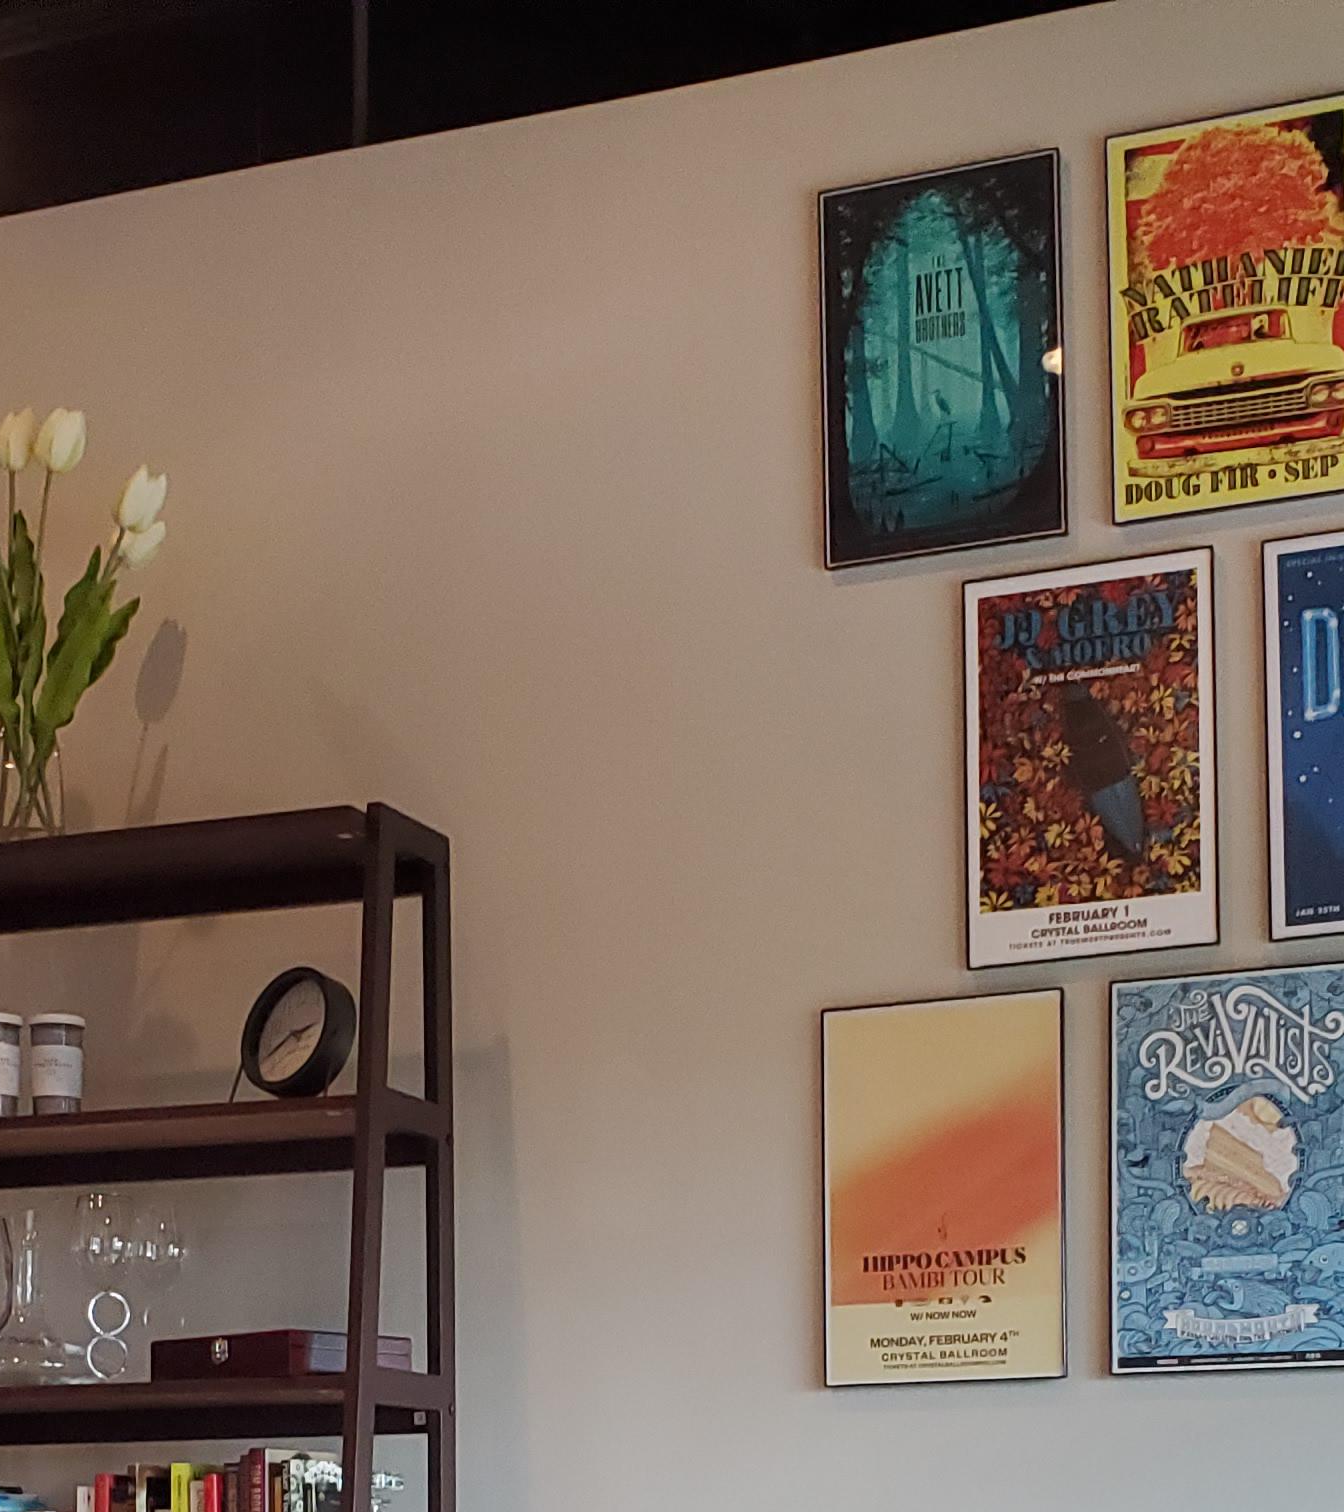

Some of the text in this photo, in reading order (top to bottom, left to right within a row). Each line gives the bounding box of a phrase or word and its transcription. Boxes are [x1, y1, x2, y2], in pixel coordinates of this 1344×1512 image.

[915, 266, 963, 316] AVETT
[915, 310, 966, 345] BROTHERS
[1125, 474, 1201, 506] DOUG
[1210, 462, 1259, 494] FIR
[1284, 454, 1340, 483] SEP
[1058, 590, 1176, 642] GREY
[1048, 904, 1130, 925] FEBRUARY 1
[1031, 918, 1148, 939] CRYSTAL BALLROOM
[1169, 989, 1214, 1032] THE
[862, 1246, 1027, 1273] HIPPO CAMPUS
[882, 1268, 1006, 1292] BAMBI TOUR
[925, 1311, 950, 1321] NOW
[951, 1309, 976, 1319] NOW
[870, 1335, 928, 1348] MONDAY,
[929, 1331, 997, 1346] FEBRUARY
[881, 1347, 1008, 1362] CRYSTAL BALLROOM
